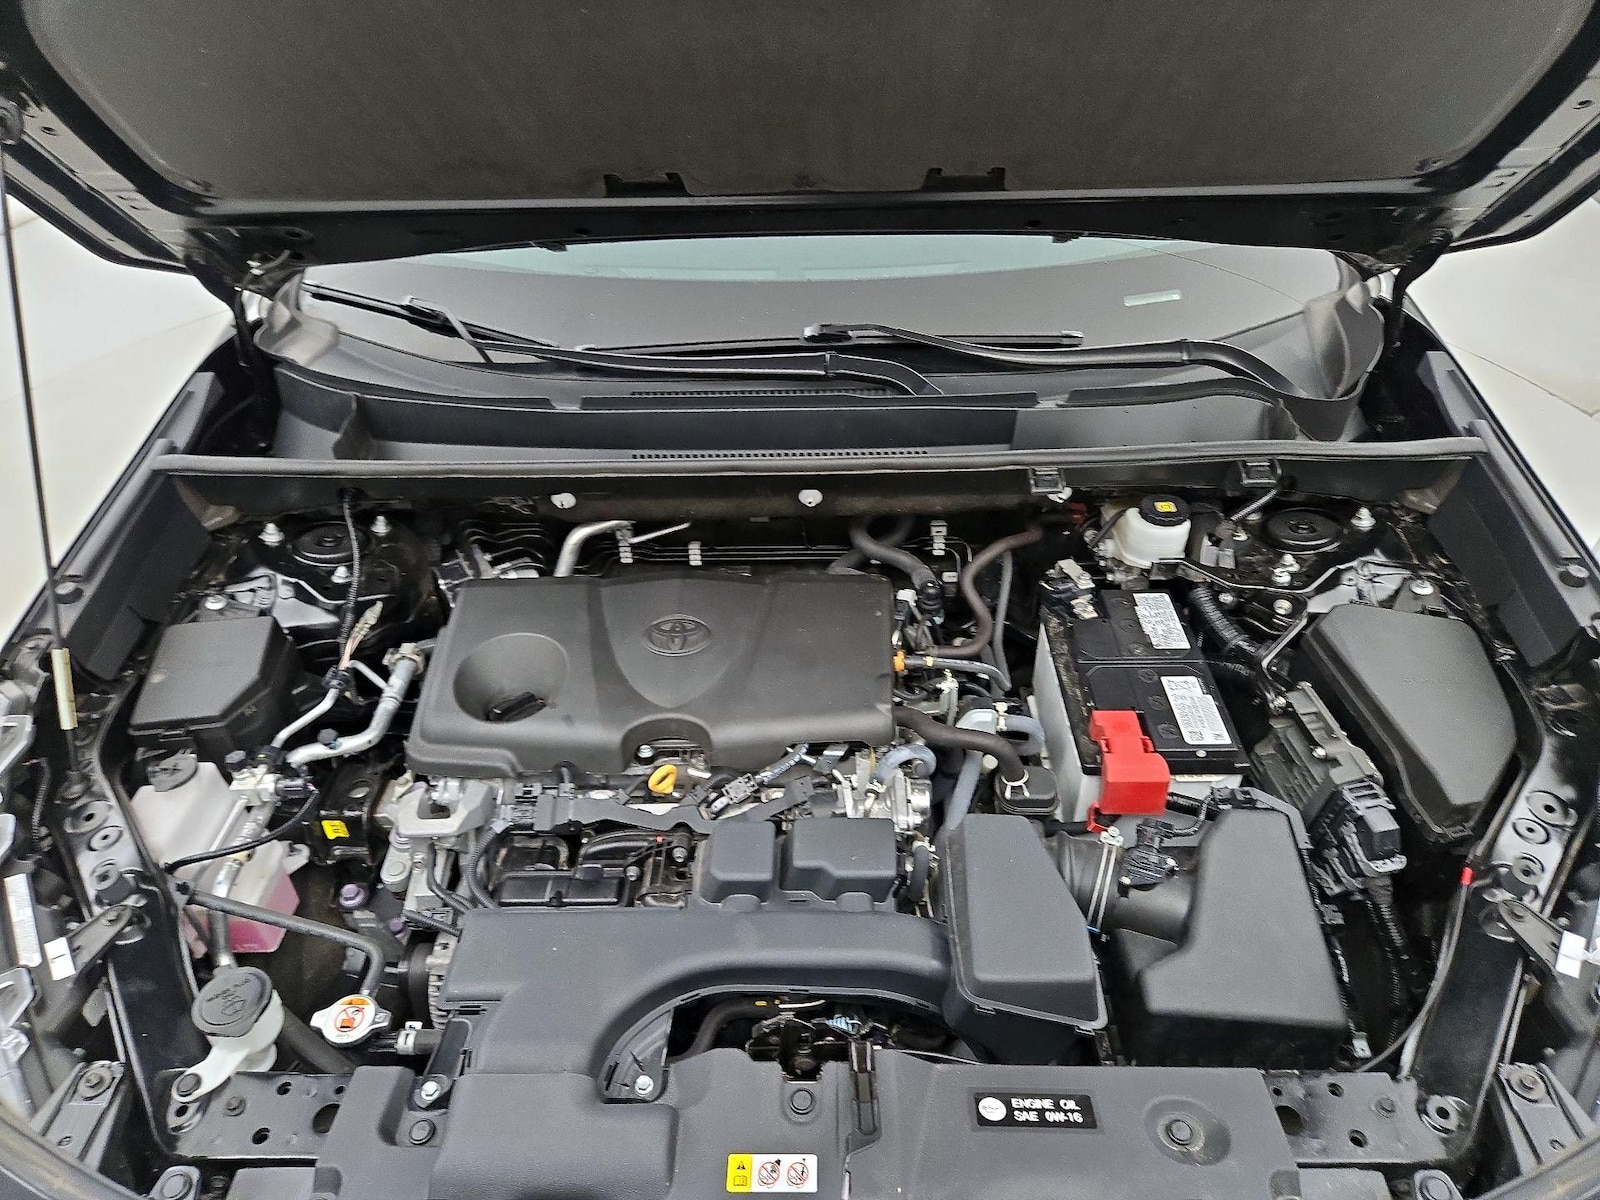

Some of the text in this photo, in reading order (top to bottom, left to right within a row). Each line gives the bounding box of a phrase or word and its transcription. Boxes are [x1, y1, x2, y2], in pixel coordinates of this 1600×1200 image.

[1011, 1098, 1055, 1110] ENGINE
[1059, 1099, 1082, 1110] OIL
[1013, 1110, 1084, 1123] SAE 0W-16
